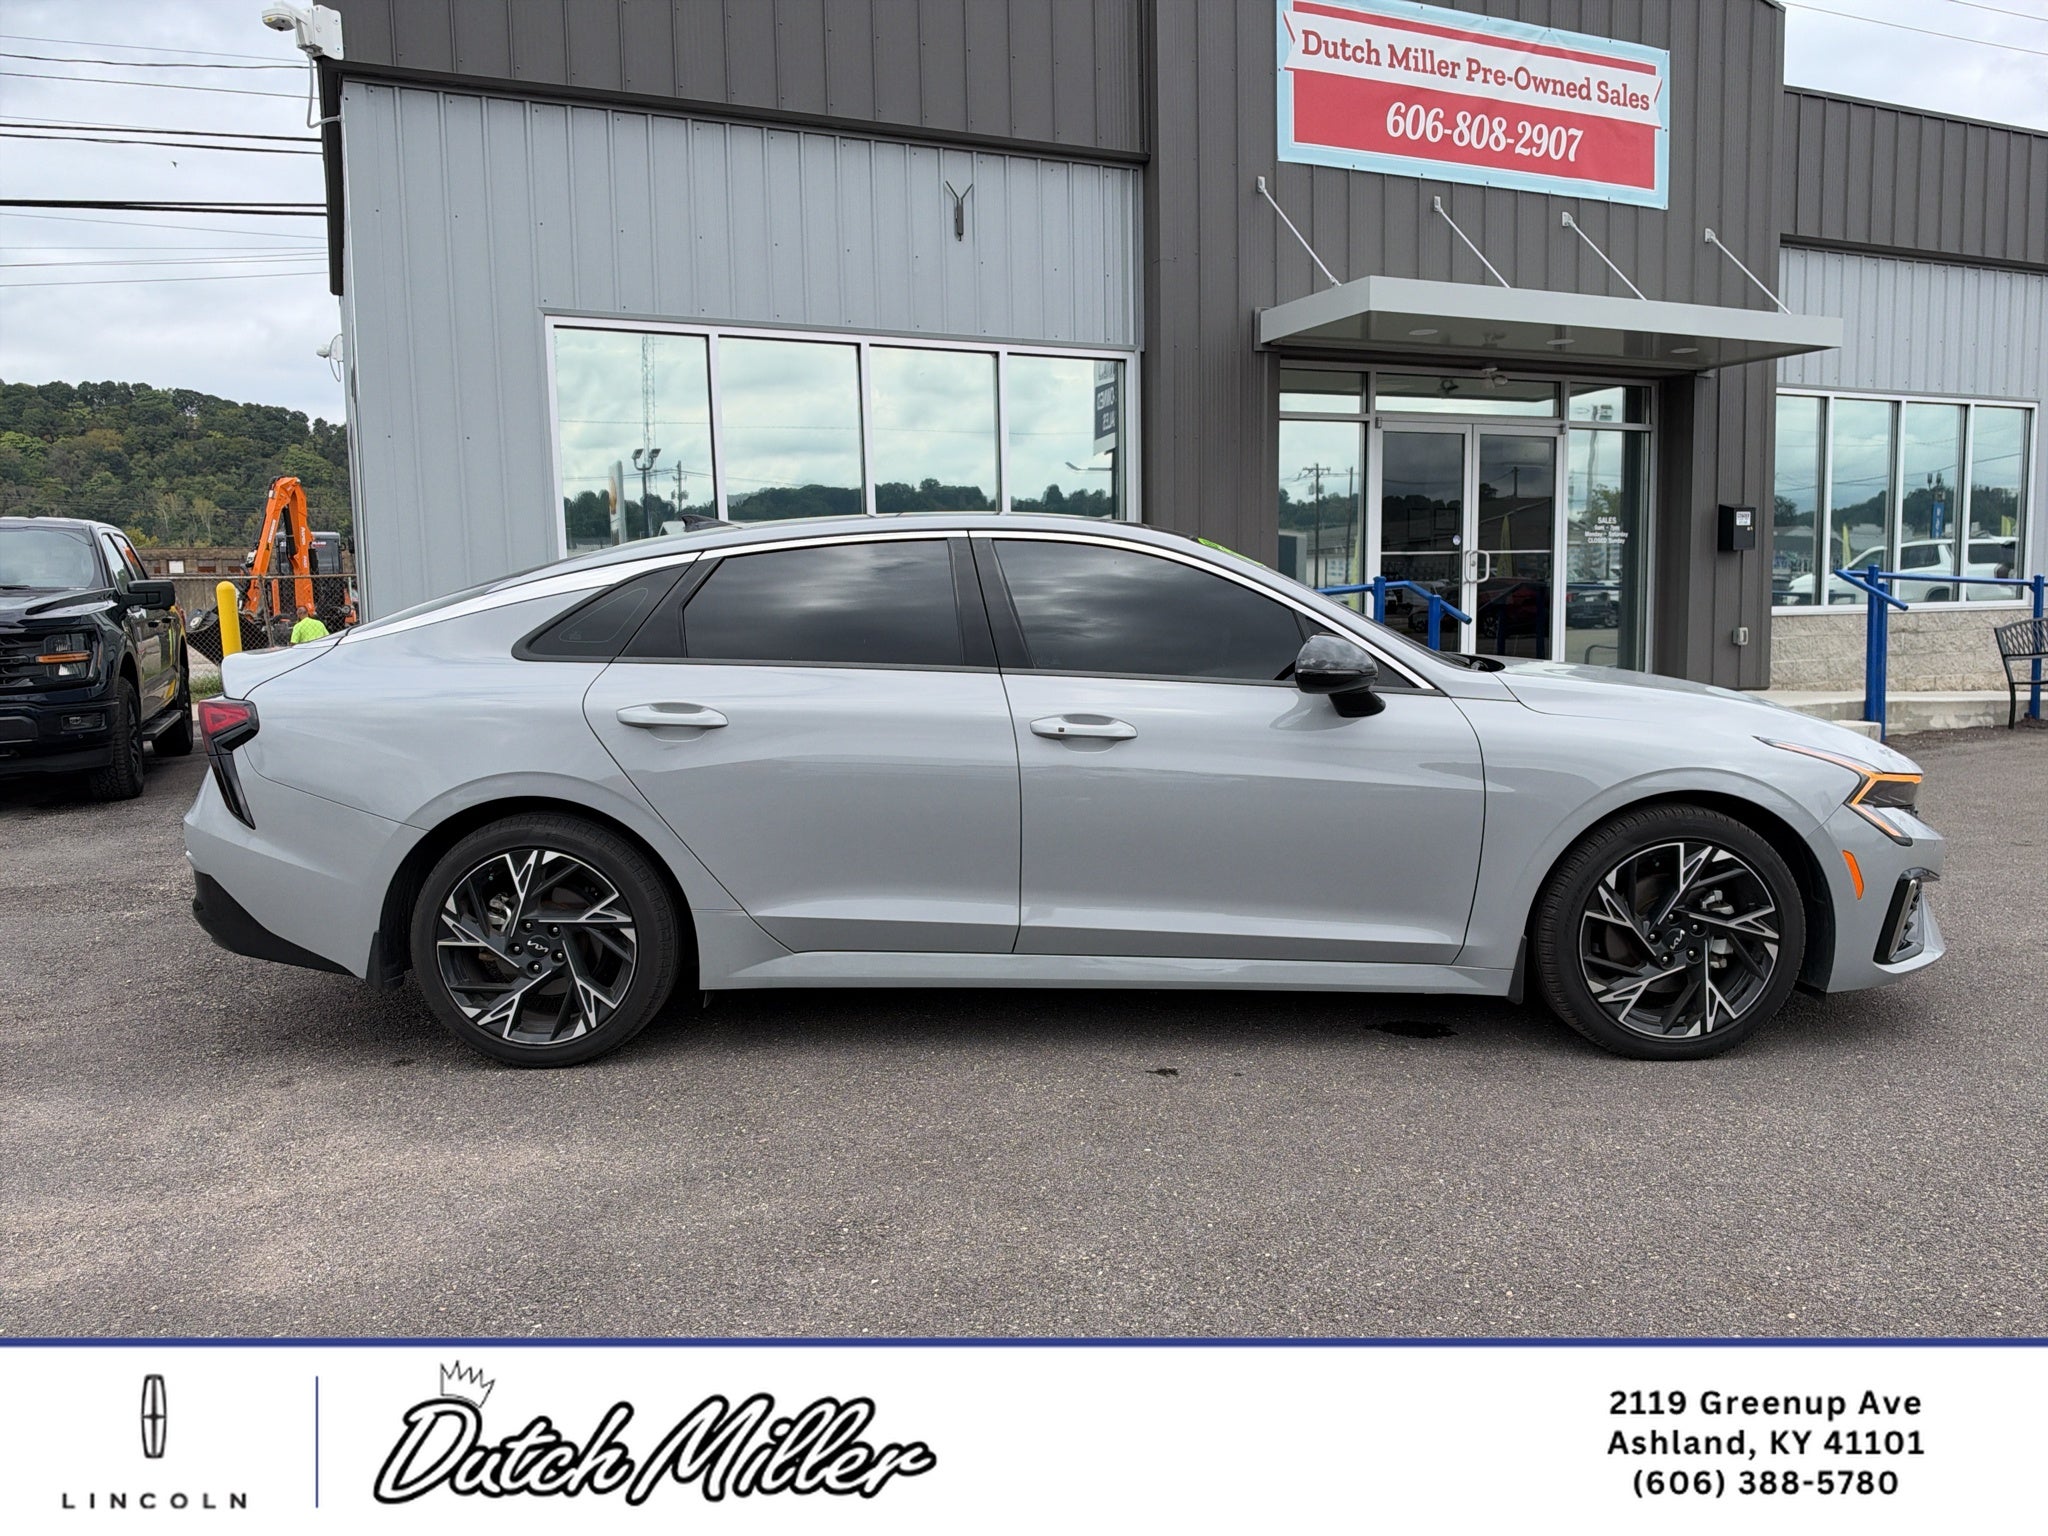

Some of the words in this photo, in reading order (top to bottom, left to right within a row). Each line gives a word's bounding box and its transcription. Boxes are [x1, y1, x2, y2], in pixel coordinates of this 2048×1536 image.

[1302, 29, 1382, 66] Dutch
[1388, 43, 1461, 80] Miller
[1466, 58, 1592, 101] Pre-Owned
[1597, 81, 1650, 111] Sales
[1386, 101, 1584, 162] 606-808-2907
[1597, 516, 1617, 524] SALES
